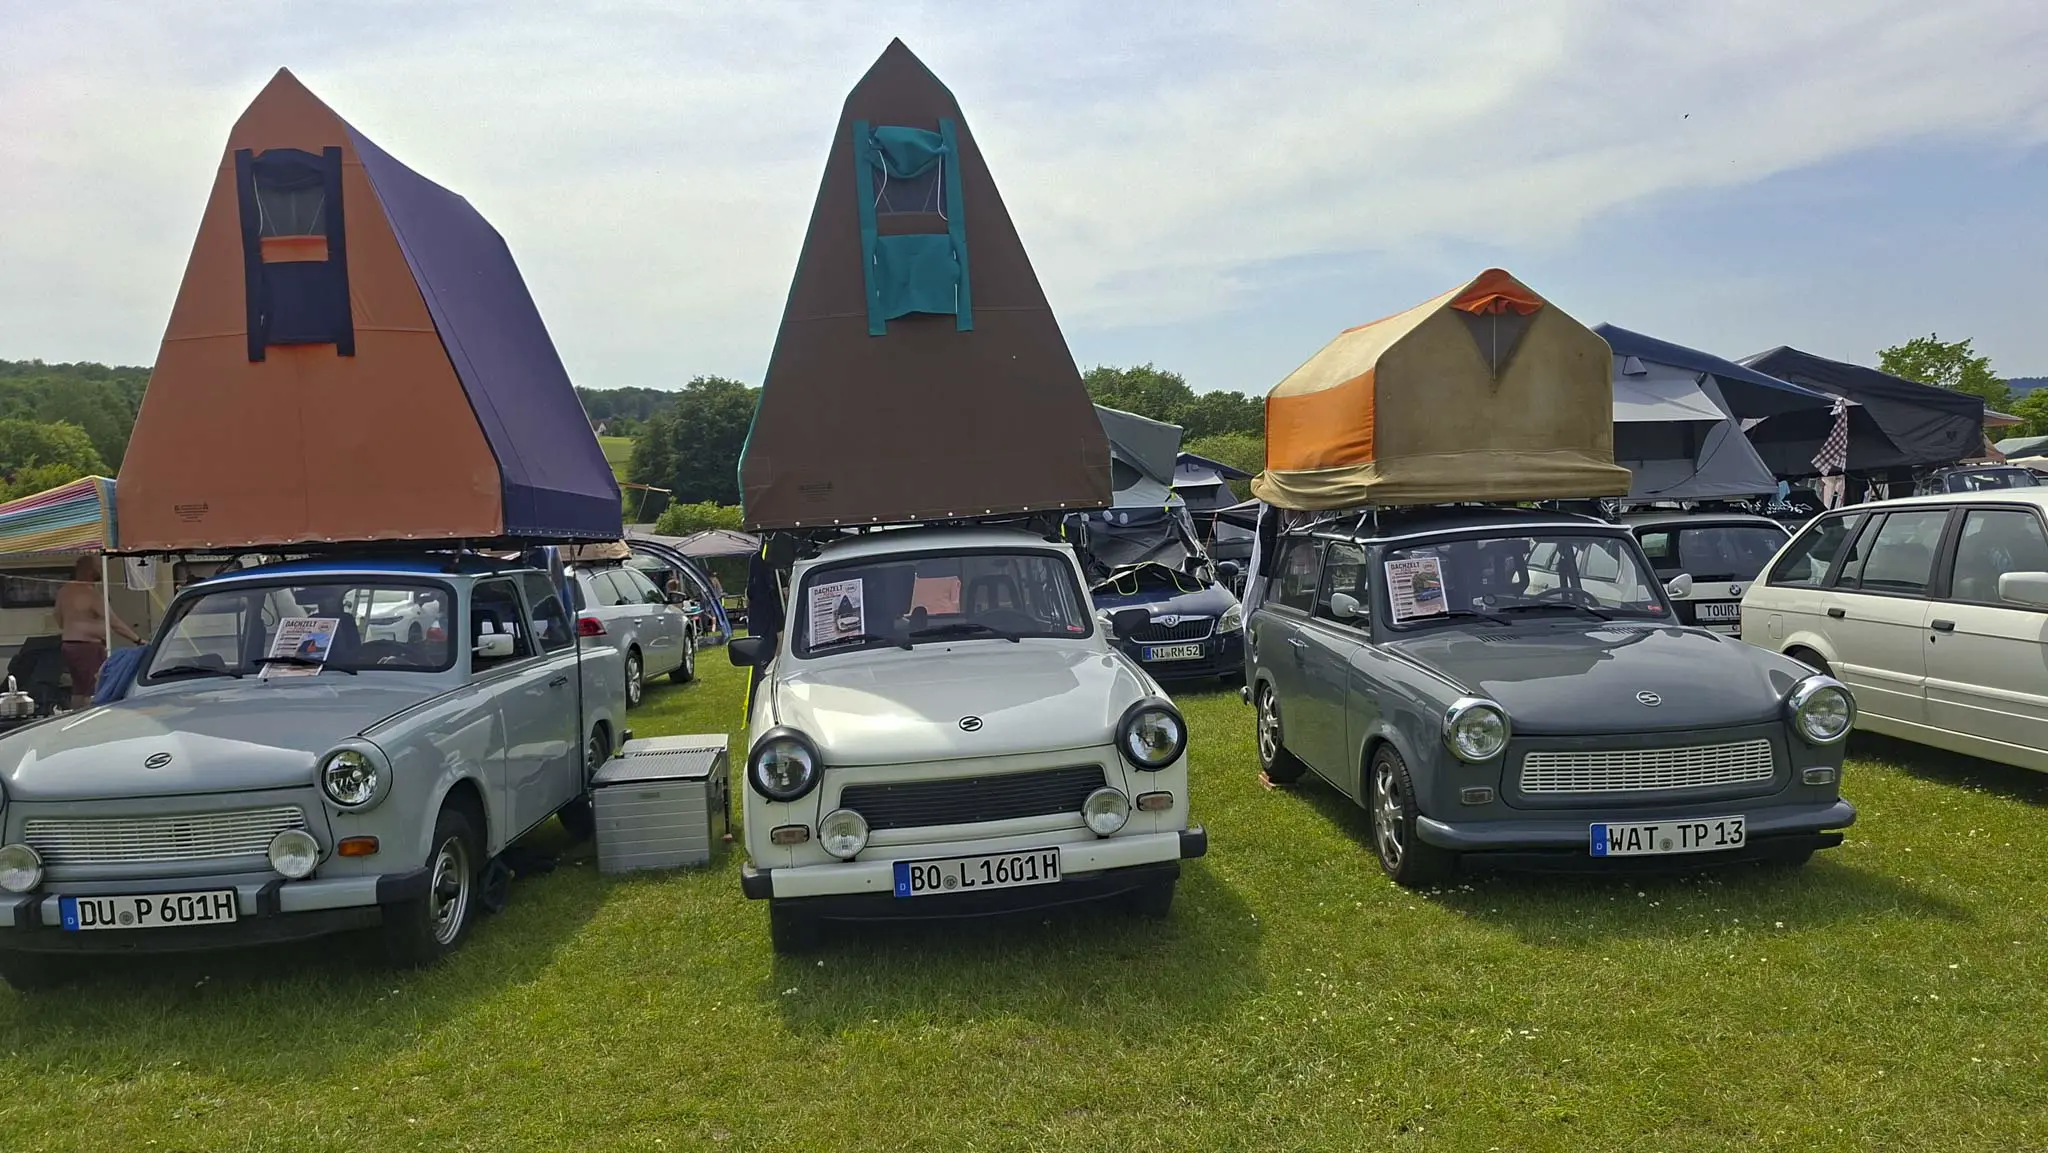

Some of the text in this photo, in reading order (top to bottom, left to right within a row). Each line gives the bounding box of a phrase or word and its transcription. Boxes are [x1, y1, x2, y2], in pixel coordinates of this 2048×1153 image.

[1152, 645, 1199, 659] NI RM 52
[1609, 826, 1659, 851] WAT
[1677, 824, 1708, 848] TP
[1715, 820, 1743, 846] 13
[911, 864, 941, 891] BO
[960, 862, 976, 887] L
[79, 900, 116, 926] DU
[134, 898, 153, 924] P
[160, 893, 233, 922] 601H
